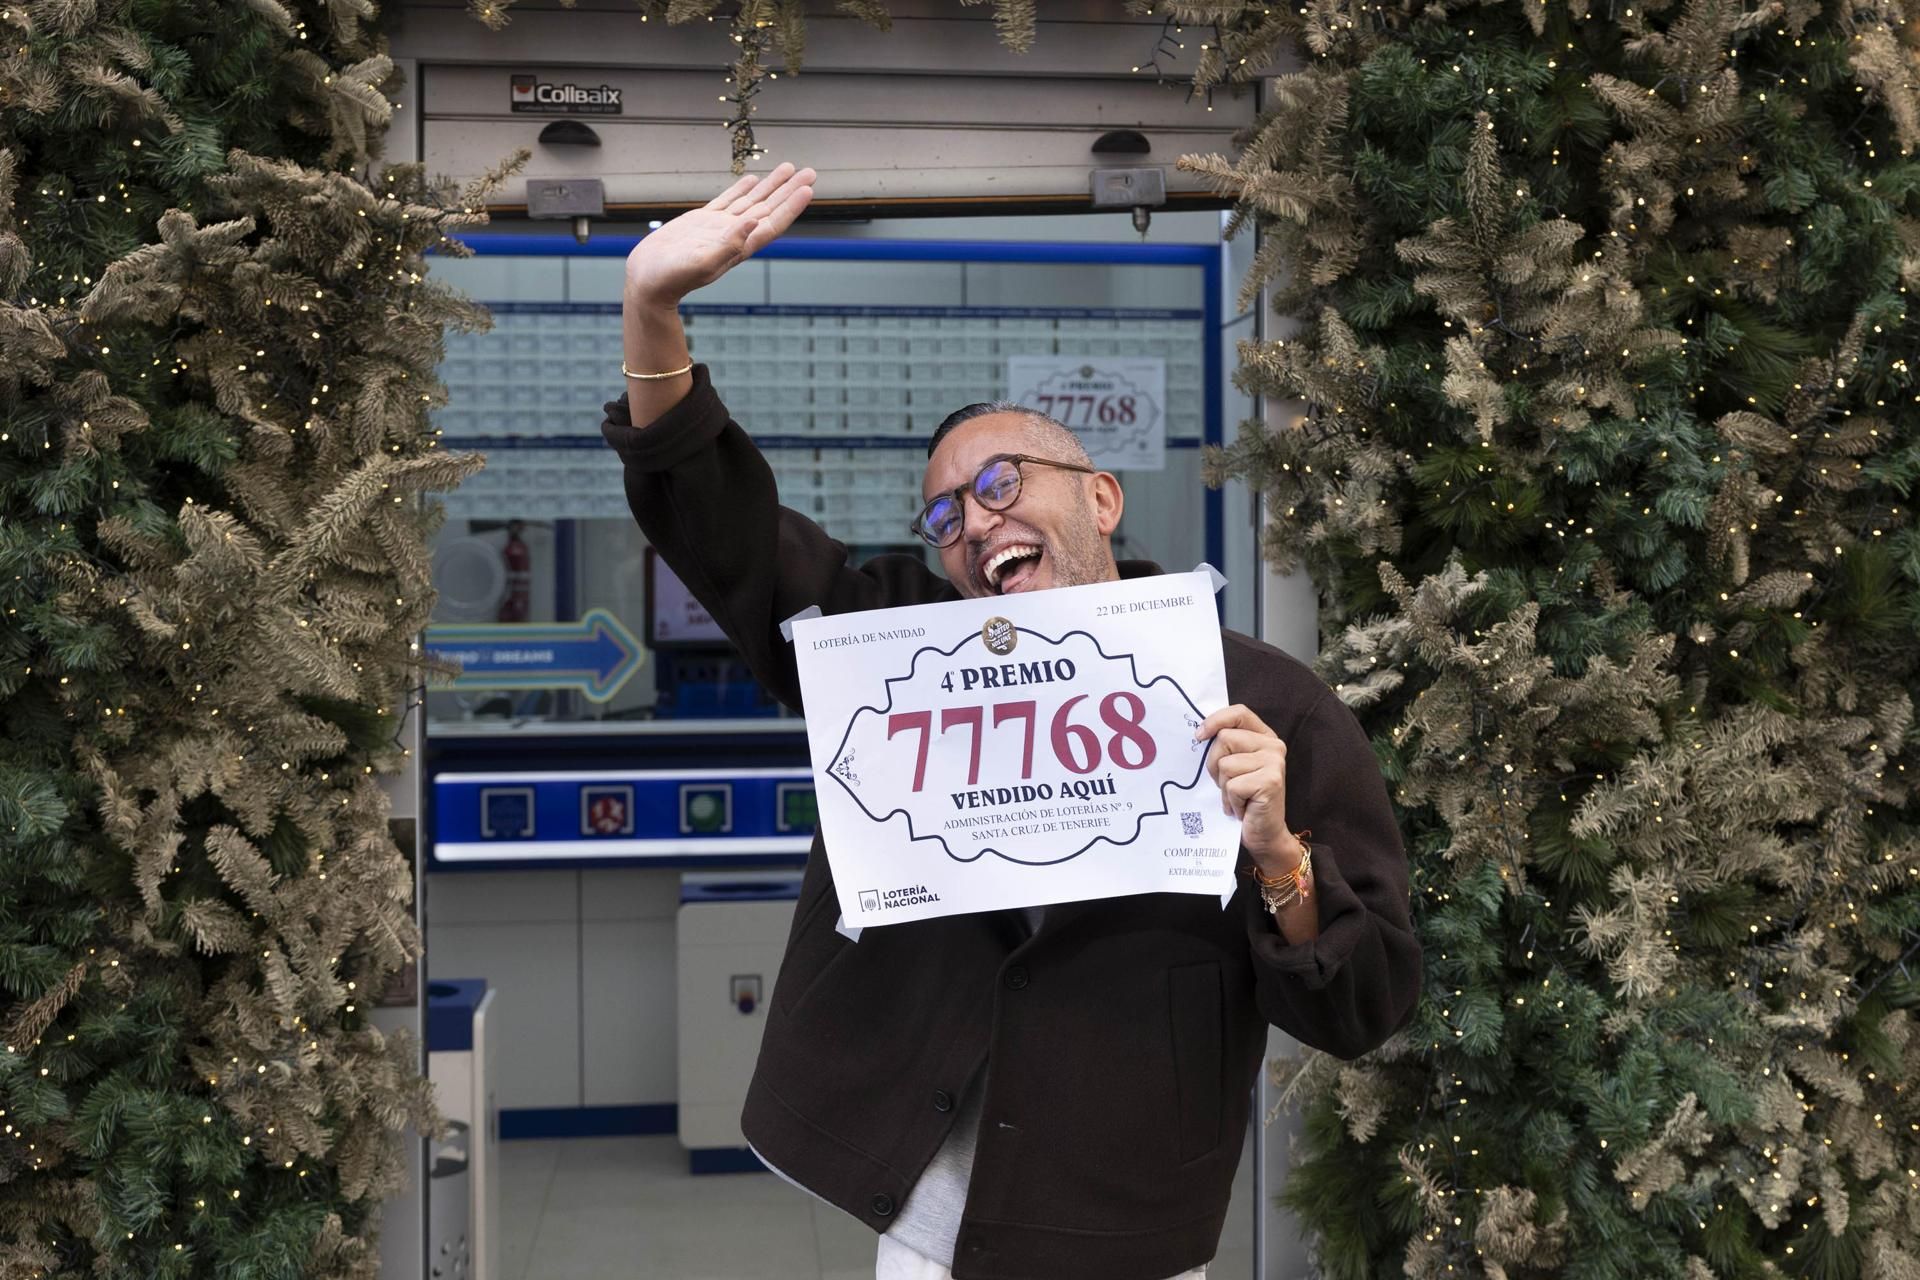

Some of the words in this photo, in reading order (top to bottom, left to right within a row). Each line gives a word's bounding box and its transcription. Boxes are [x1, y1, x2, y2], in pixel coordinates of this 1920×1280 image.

[1038, 394, 1137, 425] 77768
[1096, 606, 1108, 616] 22
[1111, 604, 1127, 614] DE
[1129, 595, 1194, 612] DICIEMBRE
[813, 632, 860, 650] LOTERÍA
[862, 633, 877, 643] DE
[878, 627, 926, 641] NAVIDAD
[960, 658, 1076, 690] PREMIO
[888, 691, 1157, 792] 77768
[951, 783, 1053, 810] VENDIDO
[1059, 773, 1117, 801] AQUÍ
[943, 808, 1038, 830] ADMINISTRACIÓN
[1040, 808, 1055, 819] DE
[1057, 801, 1108, 817] LOTERÍAS
[1126, 801, 1133, 811] 9
[972, 826, 1009, 840] SANTA
[1010, 823, 1040, 836] CRUZ
[1042, 821, 1057, 832] DE
[1058, 817, 1111, 831] TENERIFE
[1164, 848, 1227, 858] COMPARTIRLO
[883, 884, 928, 900] LOTERÍA
[884, 893, 941, 909] NACIONAL
